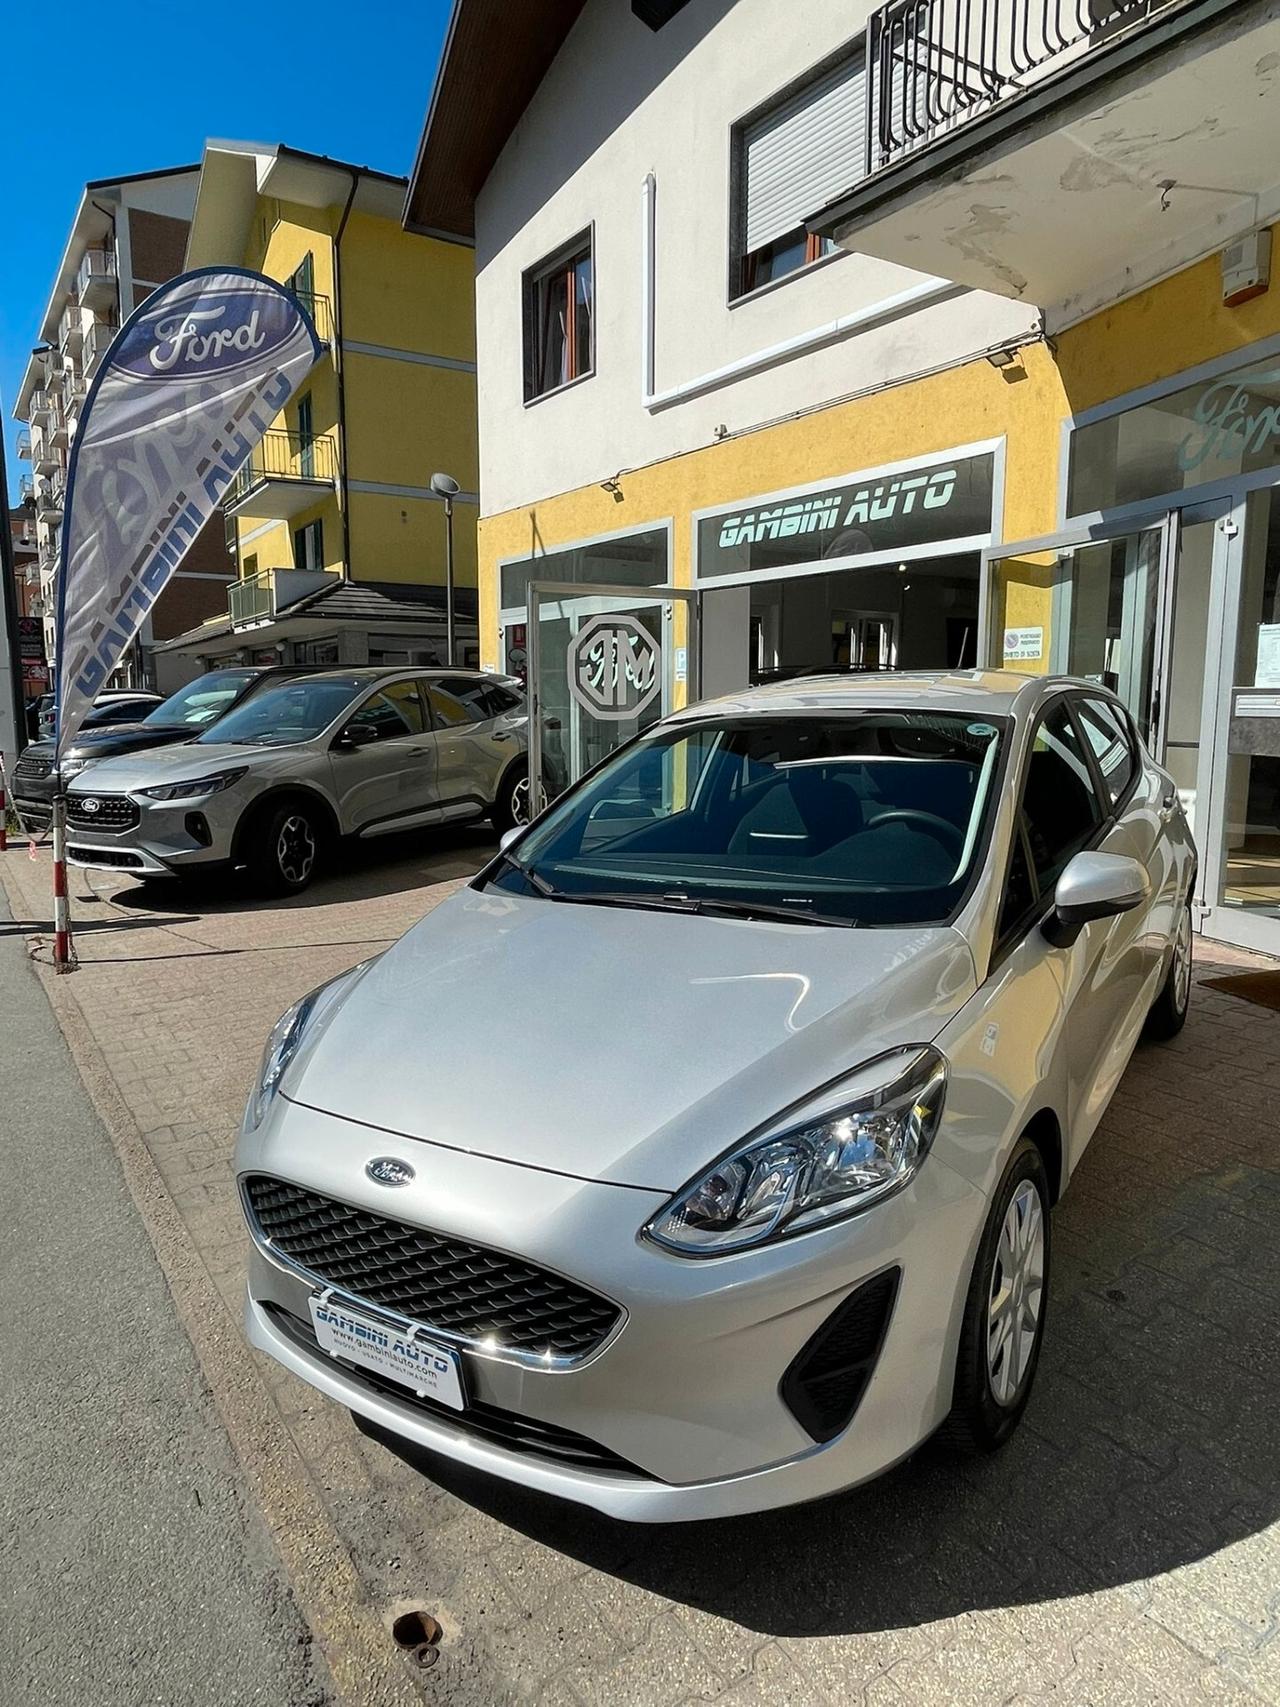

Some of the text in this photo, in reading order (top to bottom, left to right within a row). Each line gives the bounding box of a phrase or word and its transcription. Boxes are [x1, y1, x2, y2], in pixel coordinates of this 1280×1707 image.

[149, 306, 266, 370] Ford
[68, 366, 293, 698] GAMBINI AUTO
[718, 470, 957, 548] GAMBINI AUTO
[316, 1306, 449, 1373] GAMBINI AUTO
[332, 1327, 438, 1380] www.gambiniauto.com
